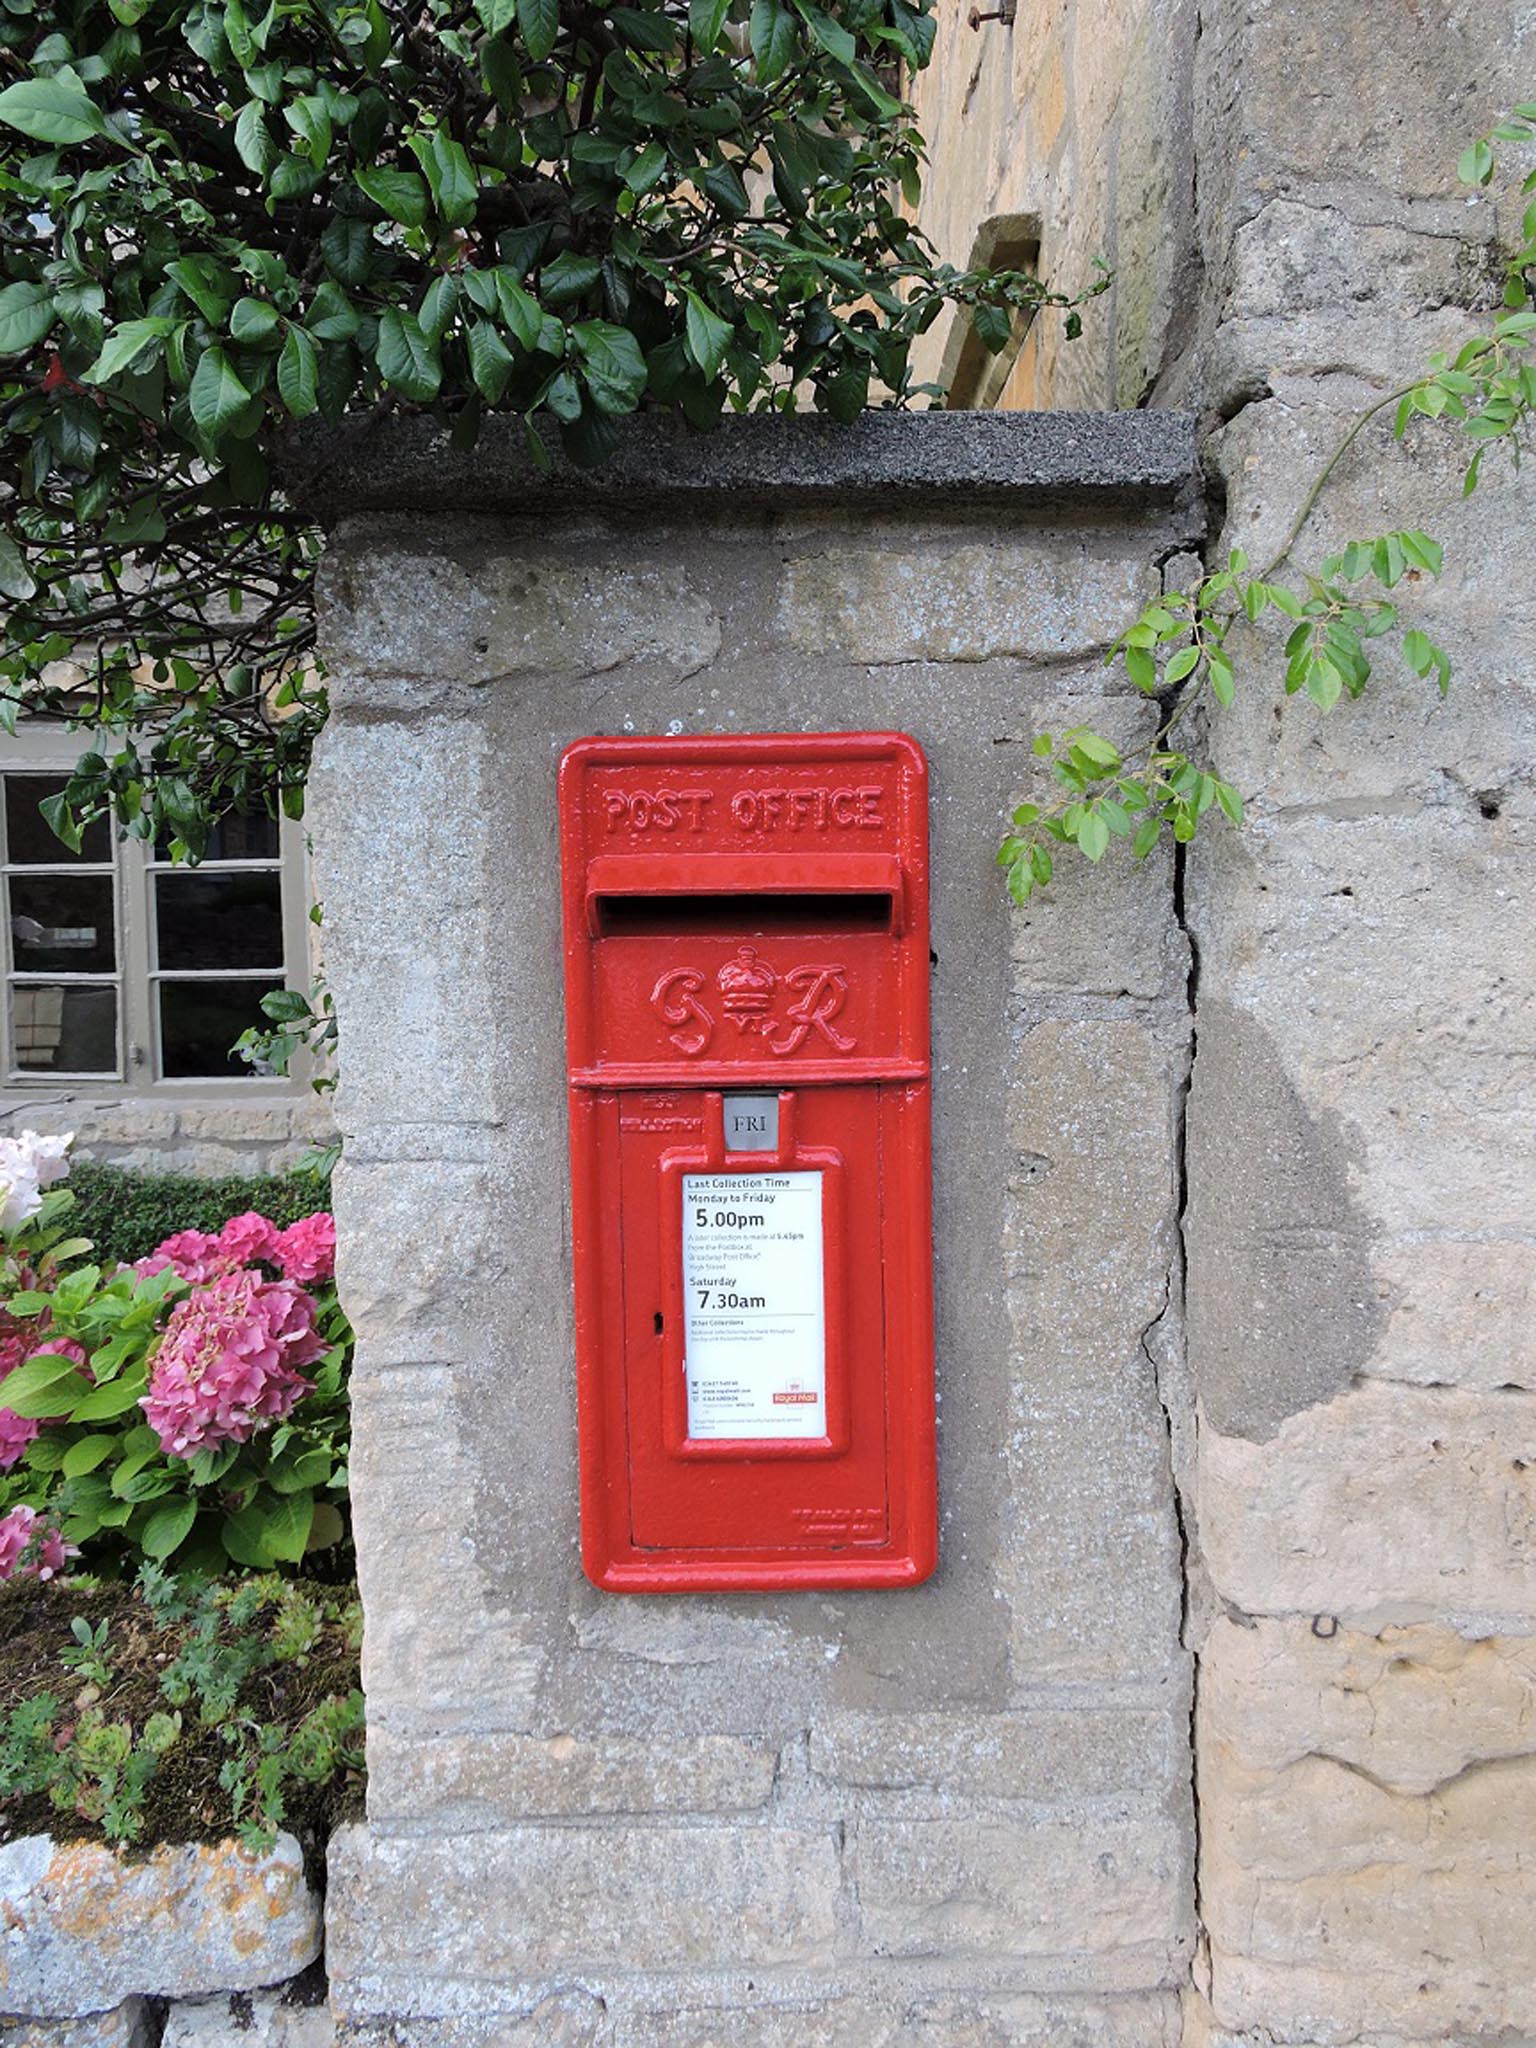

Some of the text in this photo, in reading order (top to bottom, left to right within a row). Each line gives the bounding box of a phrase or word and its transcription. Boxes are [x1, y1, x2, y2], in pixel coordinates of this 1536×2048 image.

[601, 785, 884, 832] POST OFFICE
[732, 1115, 766, 1132] FRI
[687, 1177, 790, 1189] Last Collection Time
[687, 1192, 776, 1204] Monday to Friday
[695, 1208, 764, 1230] 5.00pm
[688, 1276, 737, 1287] Saturday
[697, 1289, 766, 1309] 7.30am
